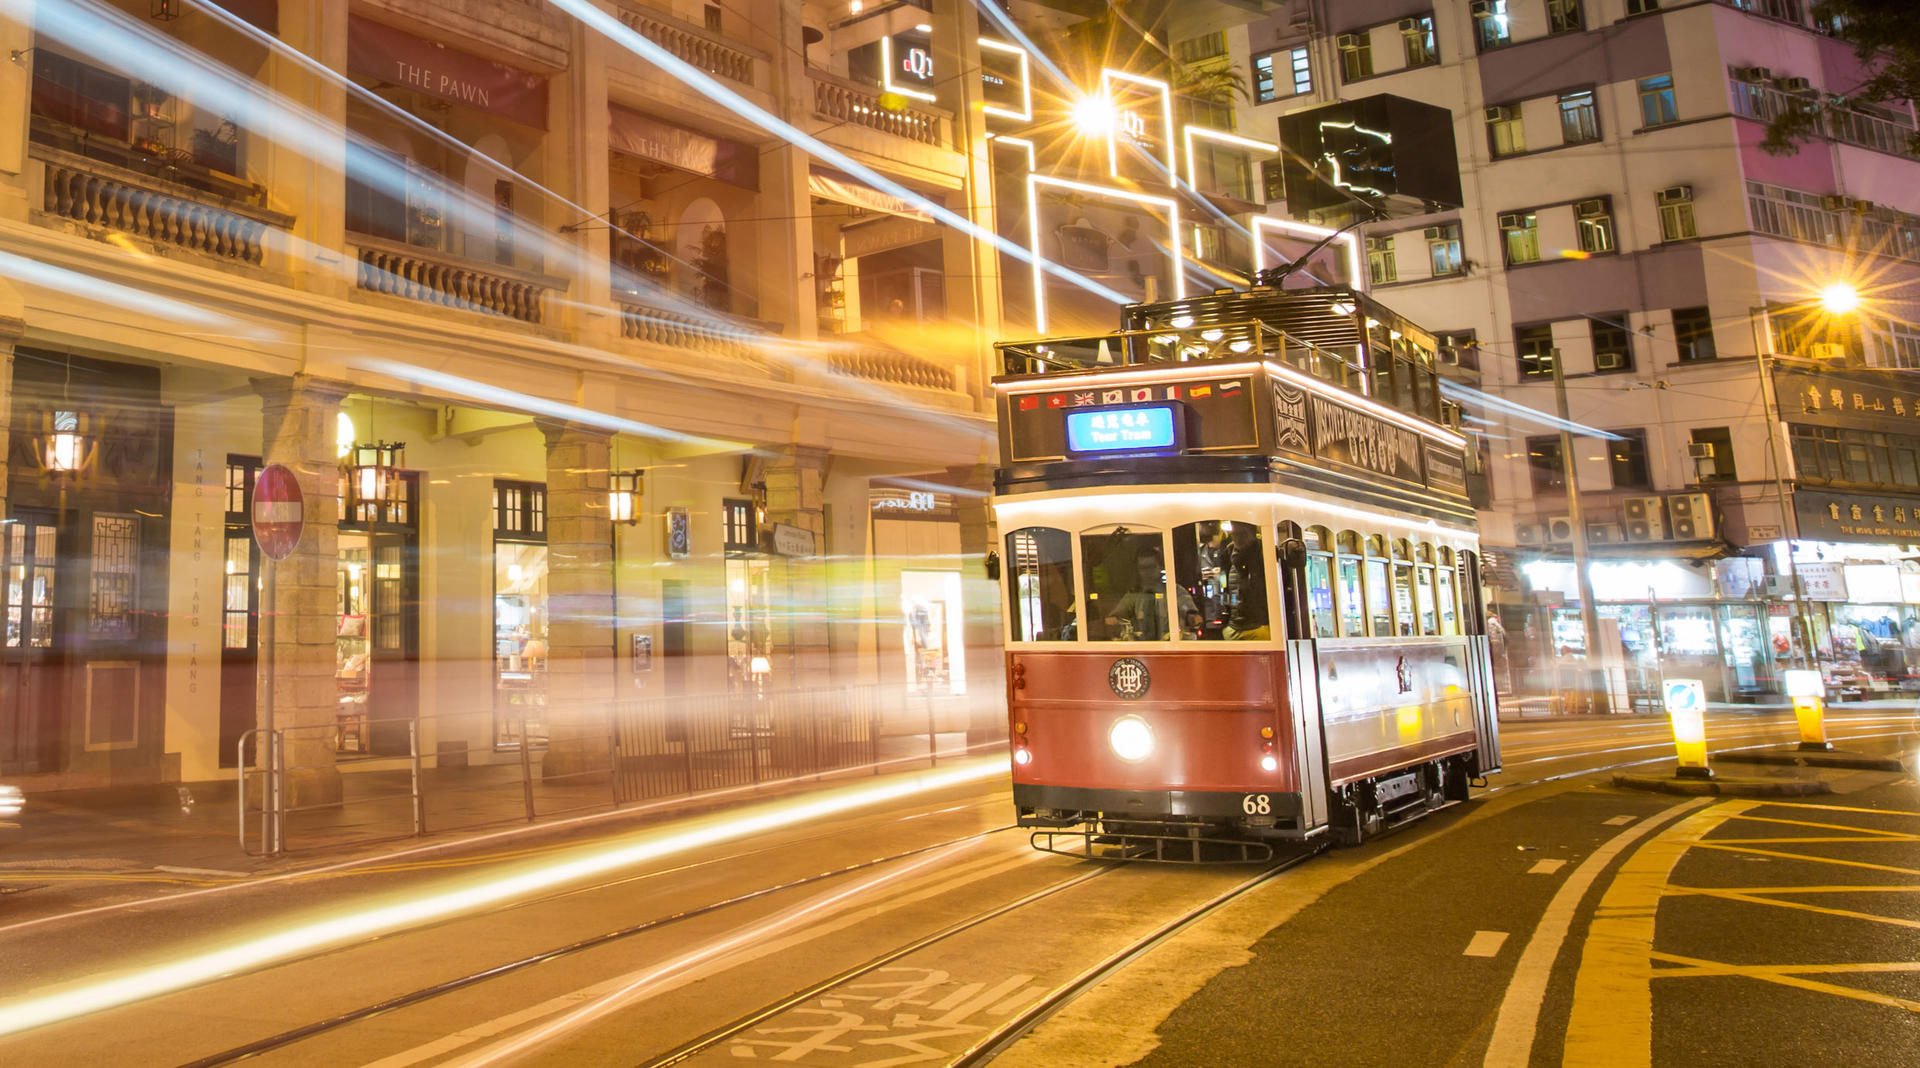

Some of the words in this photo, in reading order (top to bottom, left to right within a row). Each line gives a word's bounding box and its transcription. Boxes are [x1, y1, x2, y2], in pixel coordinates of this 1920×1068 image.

[396, 60, 432, 89] THE
[440, 75, 489, 107] PAWN
[1091, 431, 1117, 443] Tour
[1120, 429, 1152, 441] Tram
[194, 448, 204, 497] TANG
[193, 513, 204, 562] TANG
[1242, 794, 1271, 815] 68
